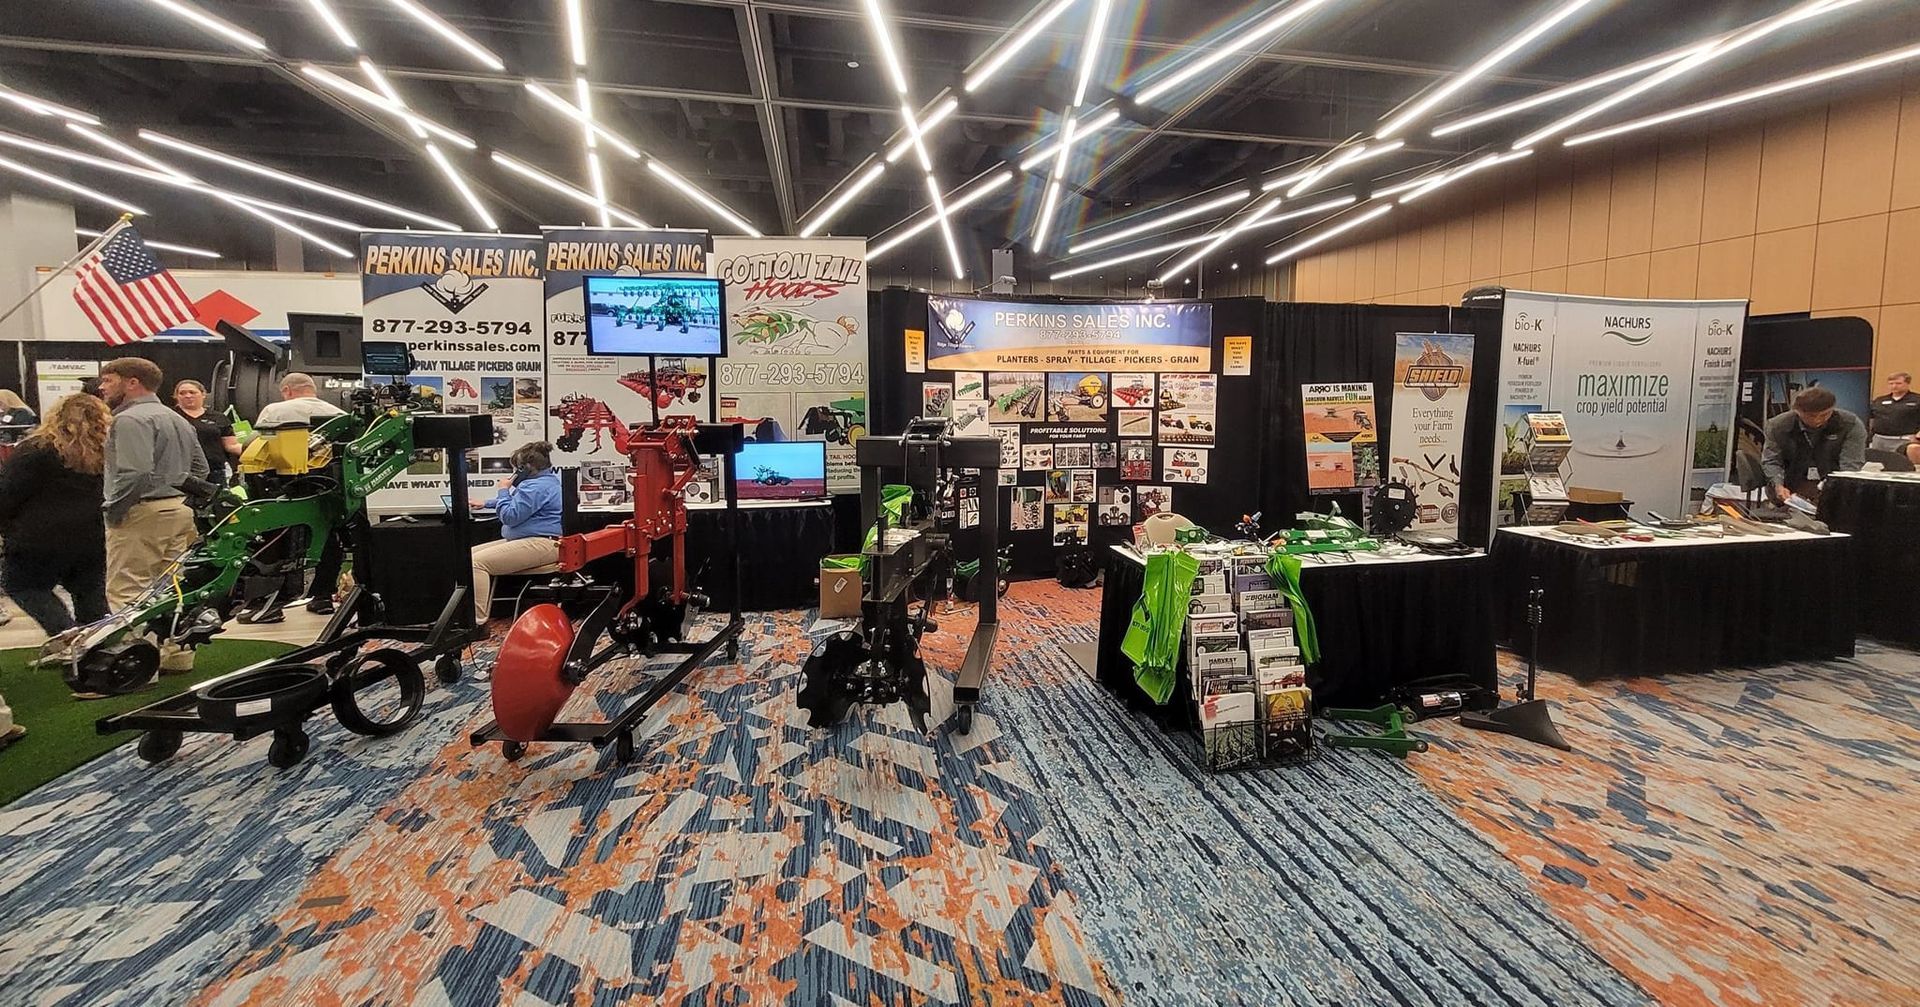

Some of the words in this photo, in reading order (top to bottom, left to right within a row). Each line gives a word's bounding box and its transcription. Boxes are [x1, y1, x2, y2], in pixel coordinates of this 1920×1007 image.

[365, 245, 446, 276] PERKINS
[449, 247, 503, 277] SALES
[507, 249, 540, 277] INC.
[546, 242, 619, 271] PERKINS
[622, 242, 673, 271] SALES
[675, 244, 705, 272] INC.
[717, 251, 811, 285] COTTON
[815, 254, 861, 284] TAIL
[995, 312, 1067, 328] PERKINS
[1072, 314, 1129, 328] SALES
[1135, 314, 1171, 328] INC.
[1604, 316, 1651, 329] NACHURS
[372, 319, 532, 335] 877-293-5794
[1512, 343, 1542, 353] NACHURS
[439, 360, 476, 371] TILLAGE
[477, 361, 514, 372] PICKERS
[515, 361, 542, 372] GRAIN
[997, 355, 1039, 363] PLANTERS
[1045, 356, 1073, 364] SPRAY
[1080, 356, 1116, 364] TILLAGE
[1124, 356, 1163, 364] PICKERS
[1170, 356, 1199, 364] GRAIN
[720, 363, 865, 386] 877-293-5794
[1409, 369, 1460, 383] SHIELD
[1341, 384, 1368, 392] MAKING
[1577, 374, 1669, 397] maximize
[1345, 393, 1358, 401] FUN
[1412, 407, 1454, 420] Everything
[1576, 400, 1598, 416] crop
[1600, 398, 1624, 416] yield
[1626, 398, 1668, 416] potential
[1414, 422, 1431, 433] your
[1432, 420, 1453, 431] Farm
[411, 480, 441, 489] WHAT
